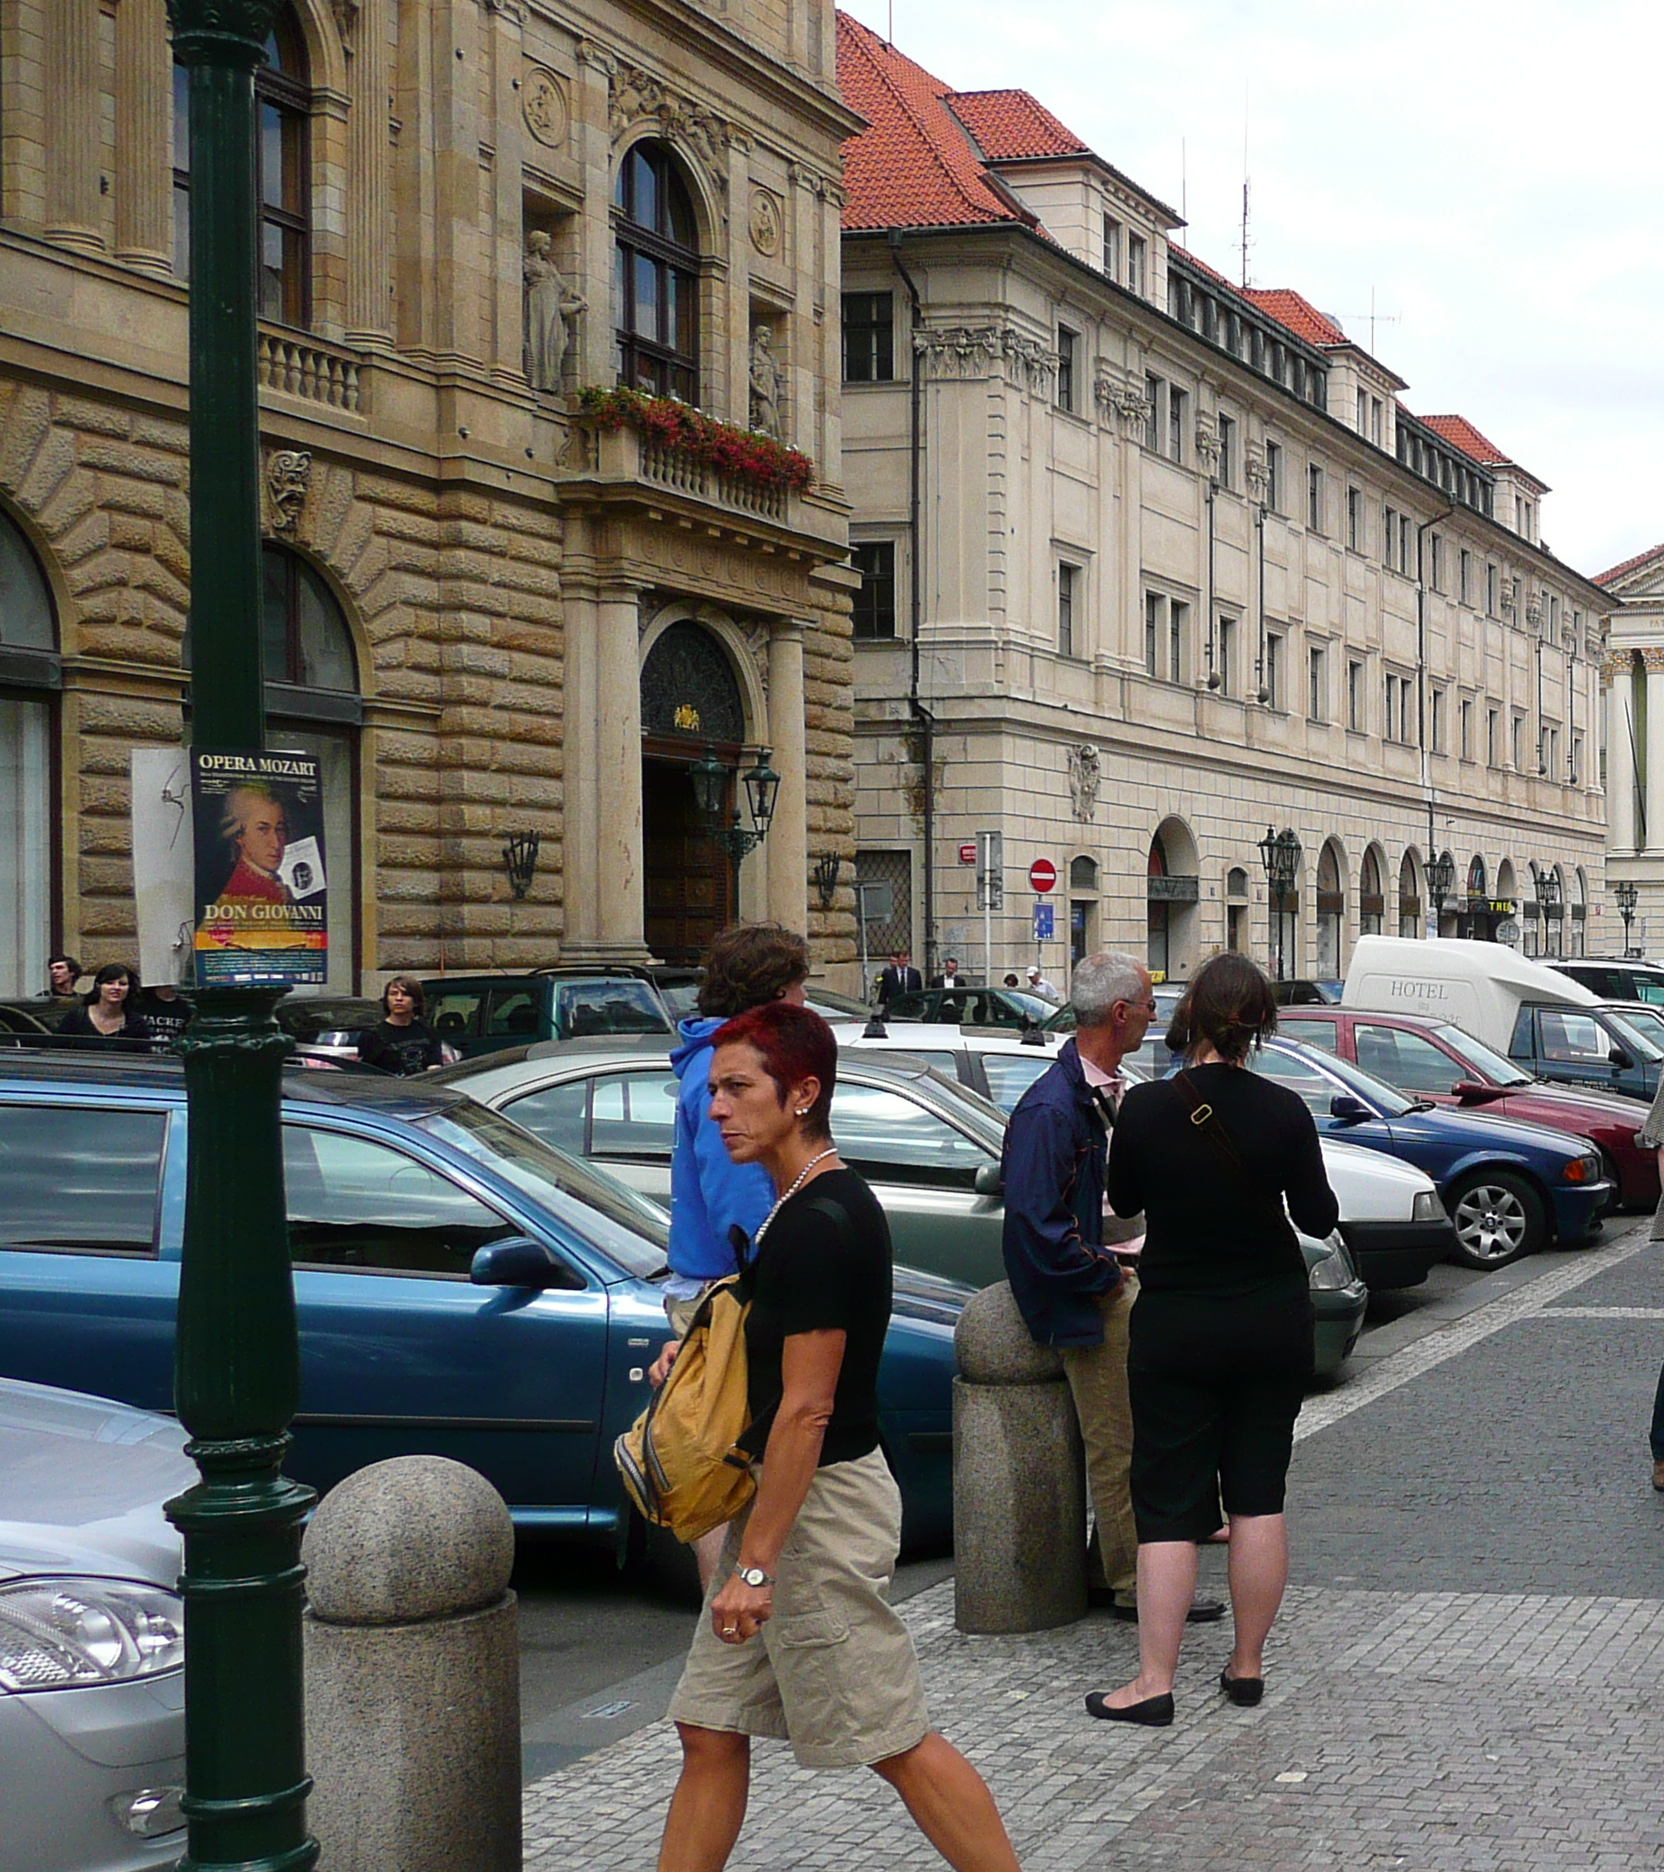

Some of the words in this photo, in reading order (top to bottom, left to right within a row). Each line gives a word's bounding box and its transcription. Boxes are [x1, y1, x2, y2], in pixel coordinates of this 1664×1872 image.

[199, 754, 257, 771] OPERA
[259, 758, 316, 776] MOZART
[204, 904, 248, 920] DON
[251, 904, 323, 920] GIOVANNI
[1391, 981, 1449, 1000] HOTEL
